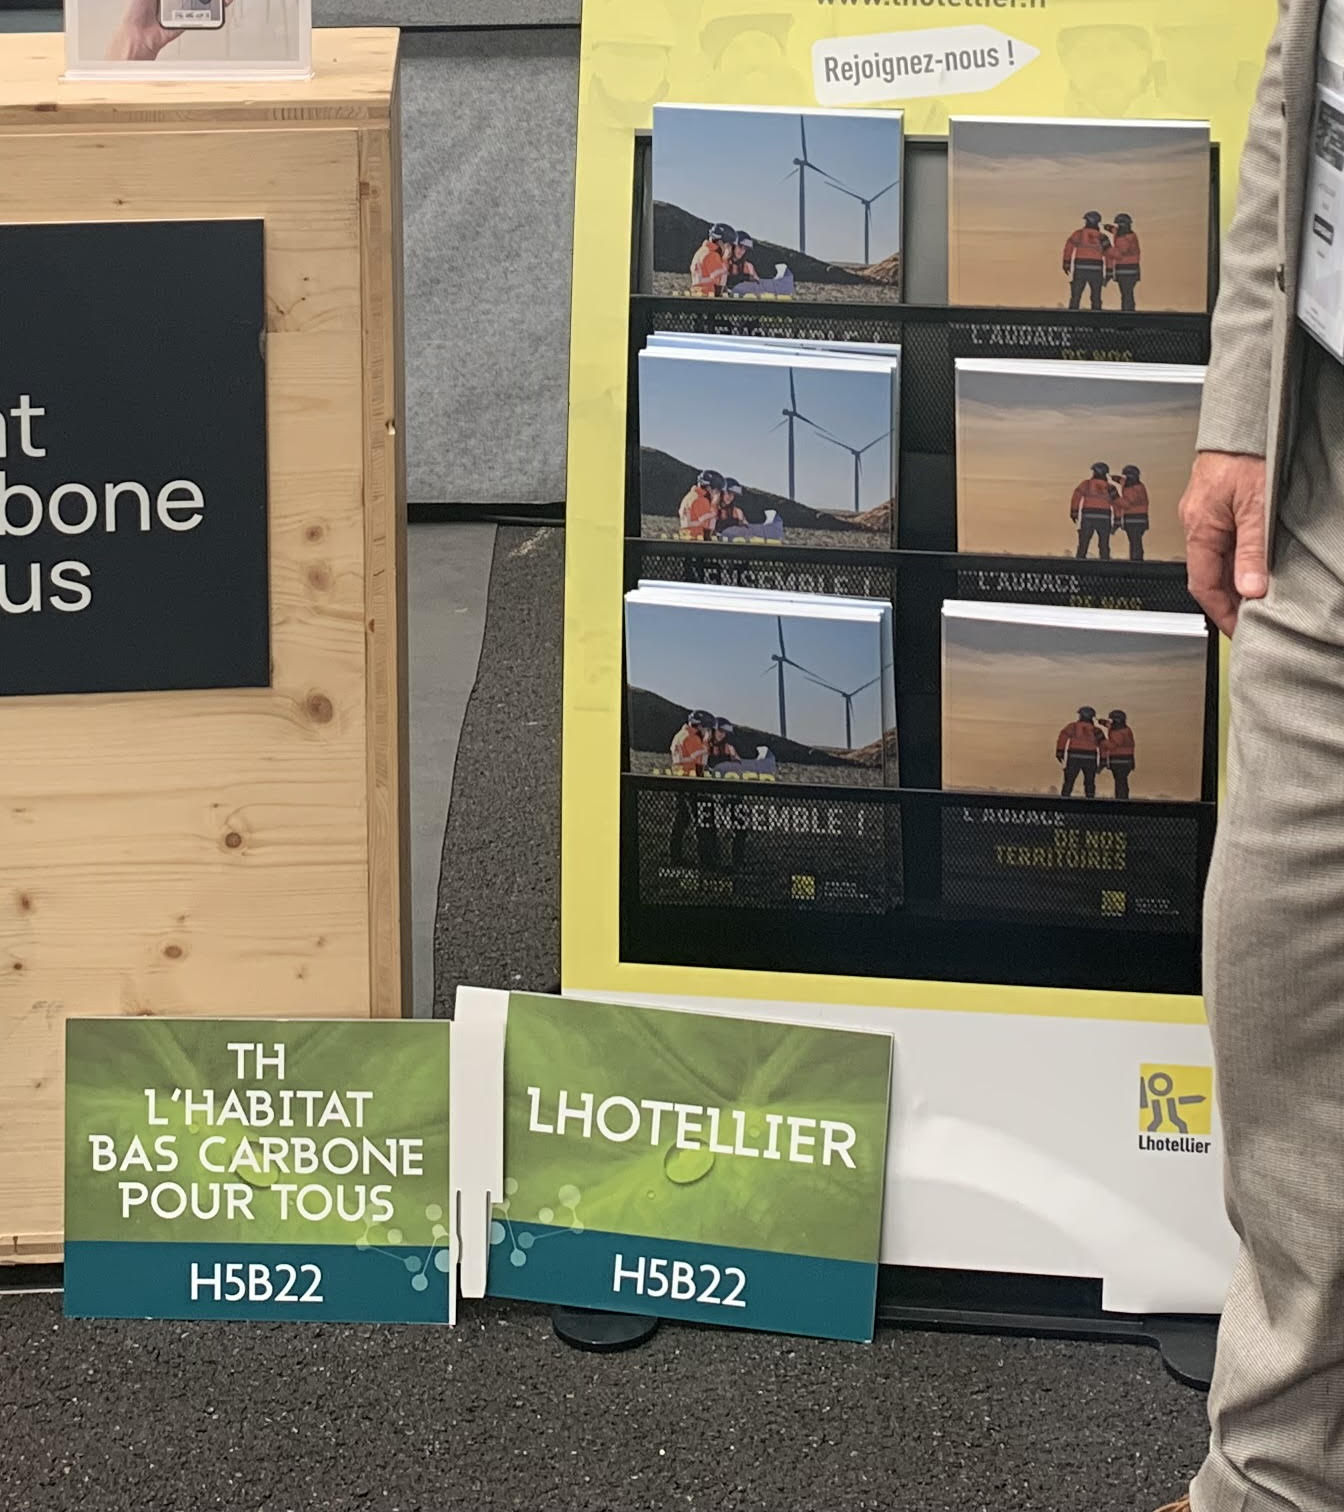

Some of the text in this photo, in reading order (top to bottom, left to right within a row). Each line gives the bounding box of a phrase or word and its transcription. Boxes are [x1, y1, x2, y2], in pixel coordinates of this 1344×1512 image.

[822, 46, 1001, 86] Rejoignez-nous
[696, 801, 844, 835] ENSEMBLE
[962, 807, 1066, 827] LAUDACE
[995, 845, 1127, 871] TERRITOIRES
[1054, 828, 1127, 850] DE NOS
[227, 1042, 287, 1081] TH
[144, 1088, 374, 1128] L'HABITAT
[527, 1086, 858, 1170] LHOTELLIER
[89, 1134, 425, 1178] BAS CARBONE
[1138, 1135, 1212, 1154] Lhotellier
[119, 1182, 395, 1223] POUR TOUS
[188, 1262, 325, 1303] H5B22
[612, 1253, 749, 1309] H5B22
